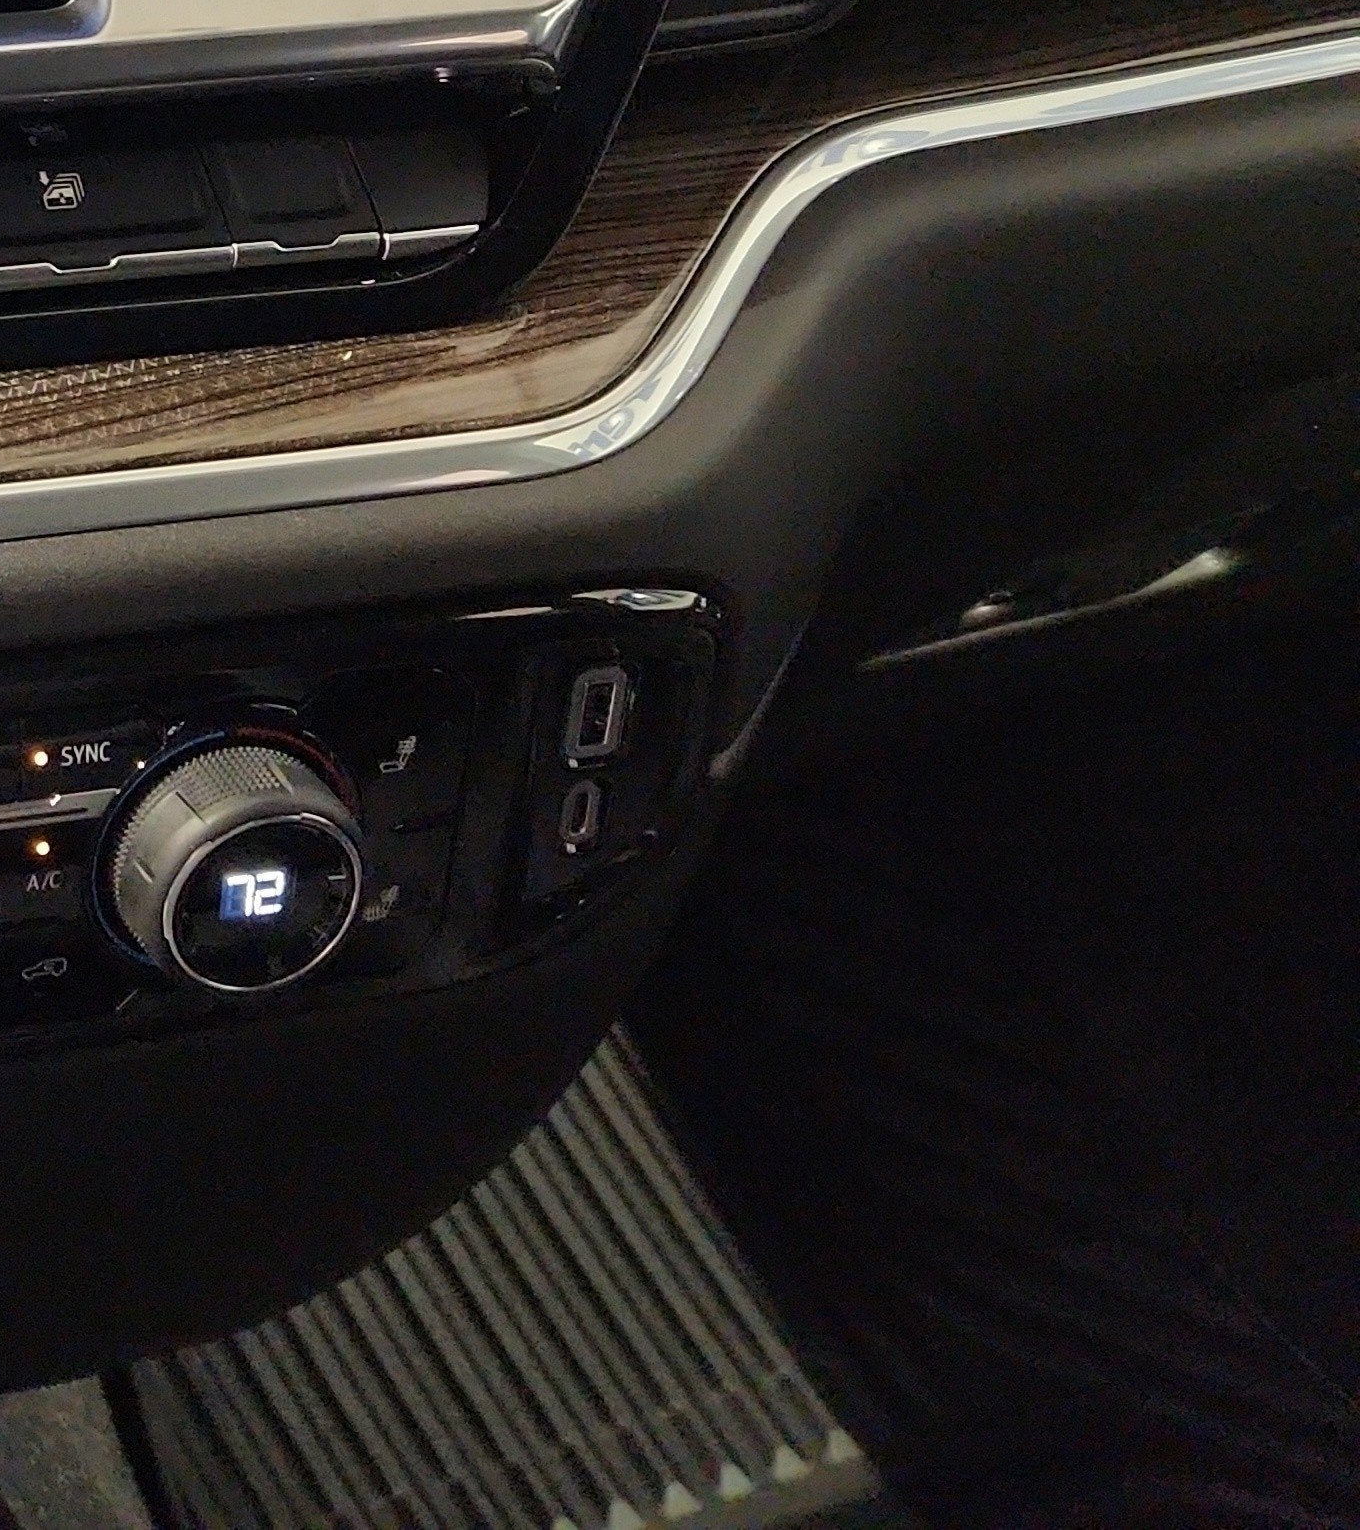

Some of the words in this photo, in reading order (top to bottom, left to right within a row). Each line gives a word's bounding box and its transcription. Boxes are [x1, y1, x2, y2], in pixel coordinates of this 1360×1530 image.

[60, 741, 111, 767] SYNC
[26, 871, 61, 892] A/C
[226, 870, 285, 918] 72
